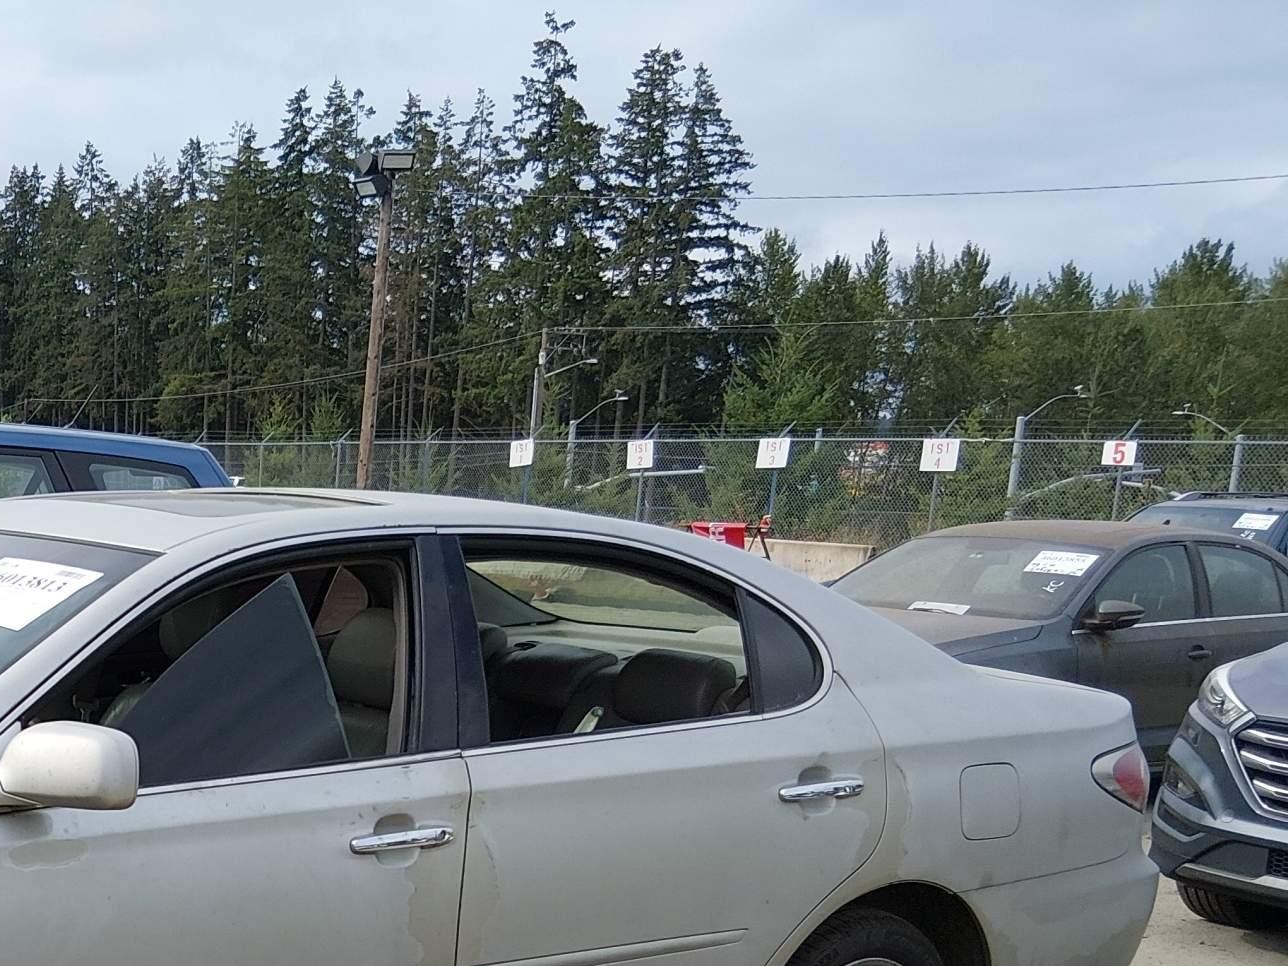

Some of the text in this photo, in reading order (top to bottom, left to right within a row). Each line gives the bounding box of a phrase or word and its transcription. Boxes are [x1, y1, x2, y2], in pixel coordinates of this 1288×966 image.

[1112, 443, 1127, 464] 5
[637, 455, 643, 466] 2
[769, 455, 775, 466] 3
[934, 456, 941, 469] 4
